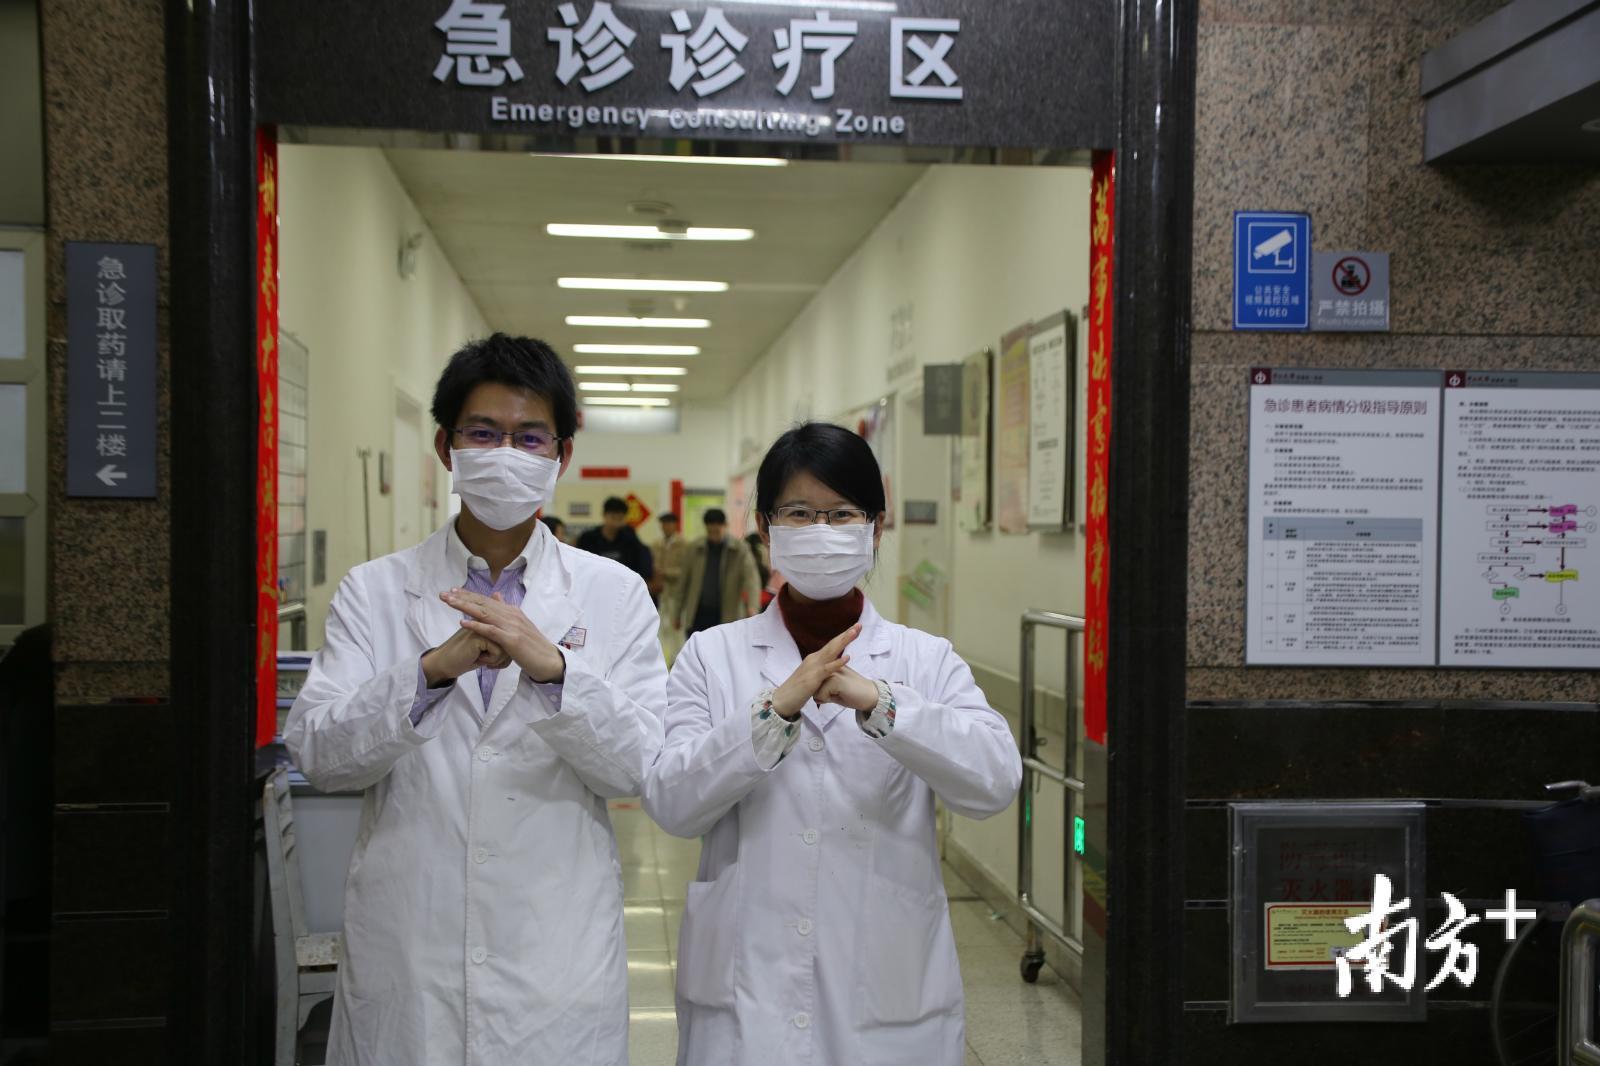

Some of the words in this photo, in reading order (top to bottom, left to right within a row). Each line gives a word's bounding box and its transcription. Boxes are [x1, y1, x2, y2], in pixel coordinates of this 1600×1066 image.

[432, 0, 964, 99] 急诊诊疗区
[491, 96, 650, 130] Emergency
[835, 108, 906, 133] Zone
[1256, 307, 1289, 318] VIDEO
[1317, 300, 1385, 317] 严禁拍摄
[96, 256, 127, 457] 急诊取药请上二楼
[1264, 398, 1428, 416] 急诊患者病情分级指导原则
